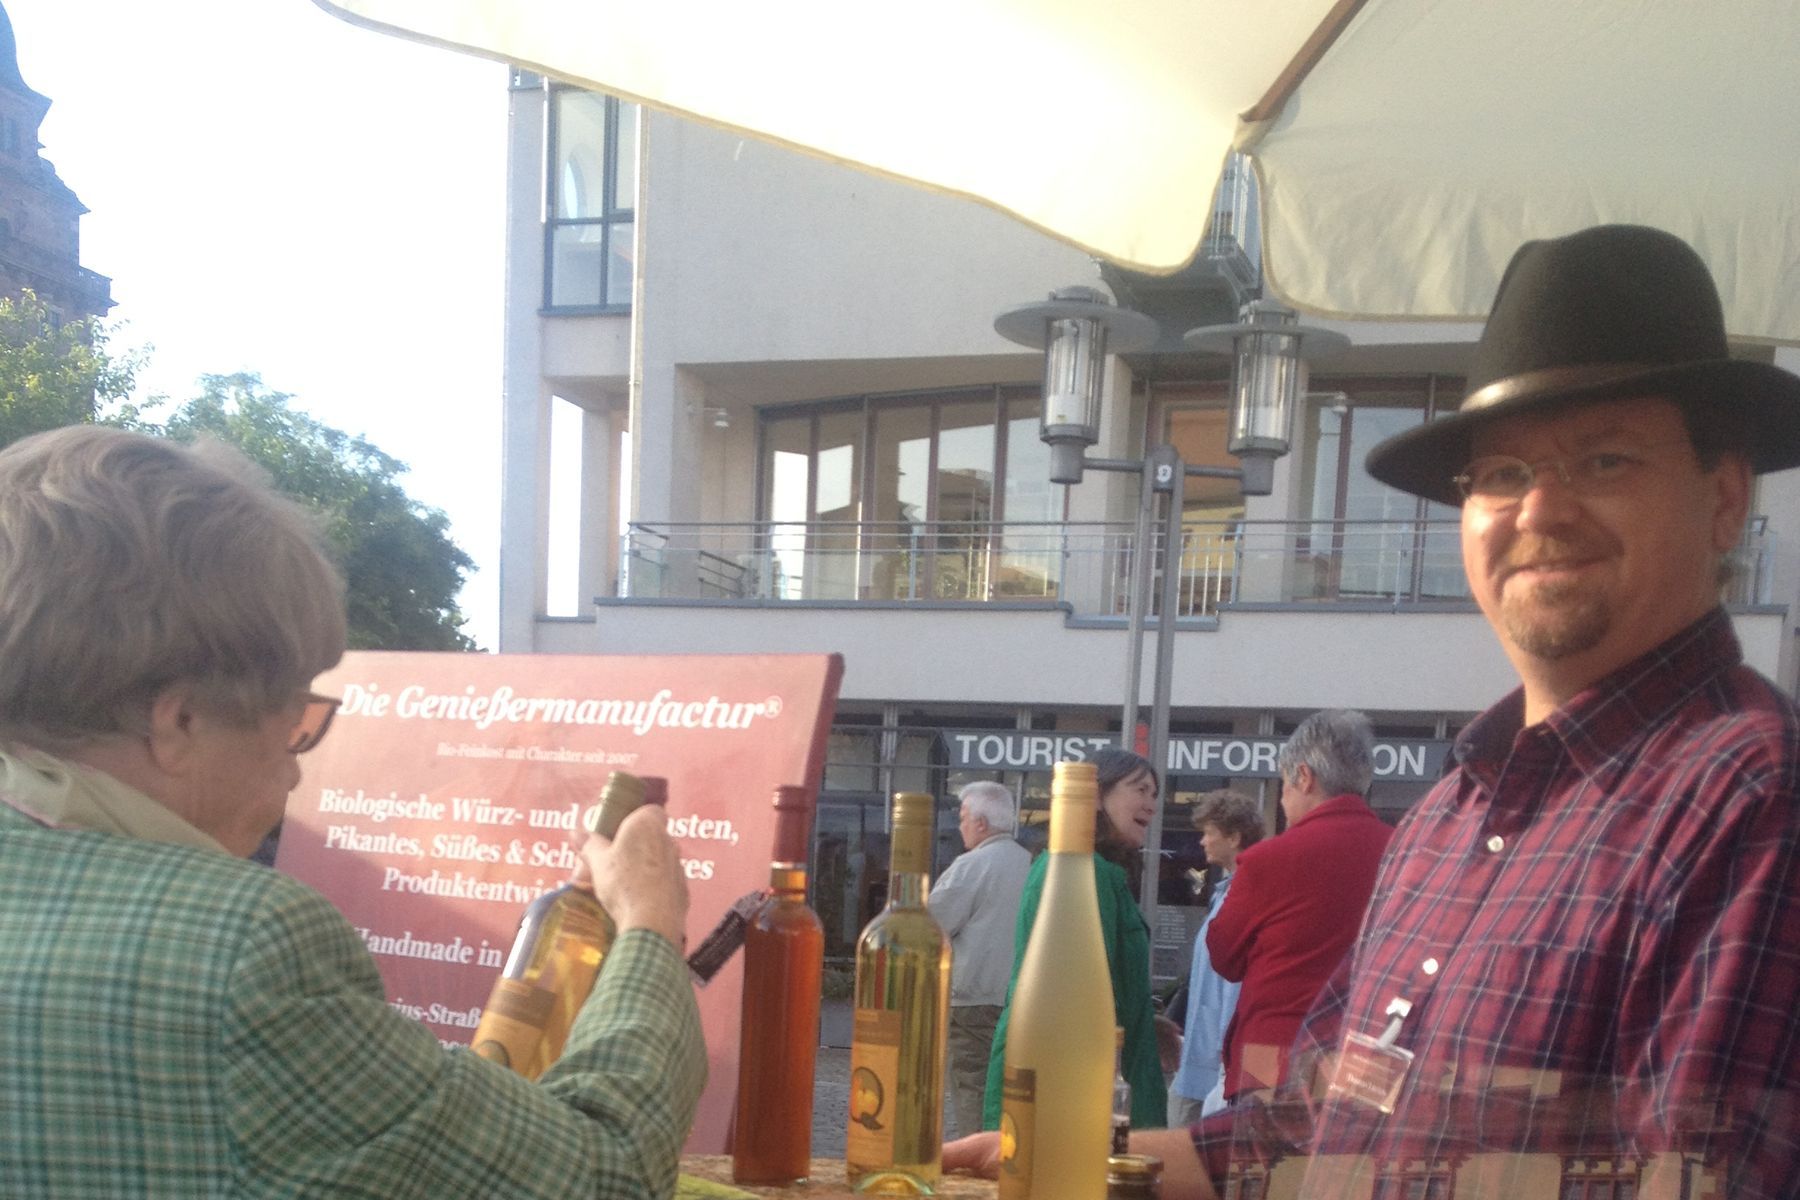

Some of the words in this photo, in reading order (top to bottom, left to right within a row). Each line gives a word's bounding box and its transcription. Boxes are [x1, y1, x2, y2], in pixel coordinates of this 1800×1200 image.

[336, 683, 391, 717] Die
[1167, 740, 1426, 776] INFORON
[318, 788, 446, 822] Biologische
[451, 797, 525, 827] Würz-
[529, 803, 578, 830] und
[324, 825, 426, 859] Pikantes,
[431, 833, 502, 863] Süßes
[505, 839, 526, 866] &
[477, 940, 503, 968] in
